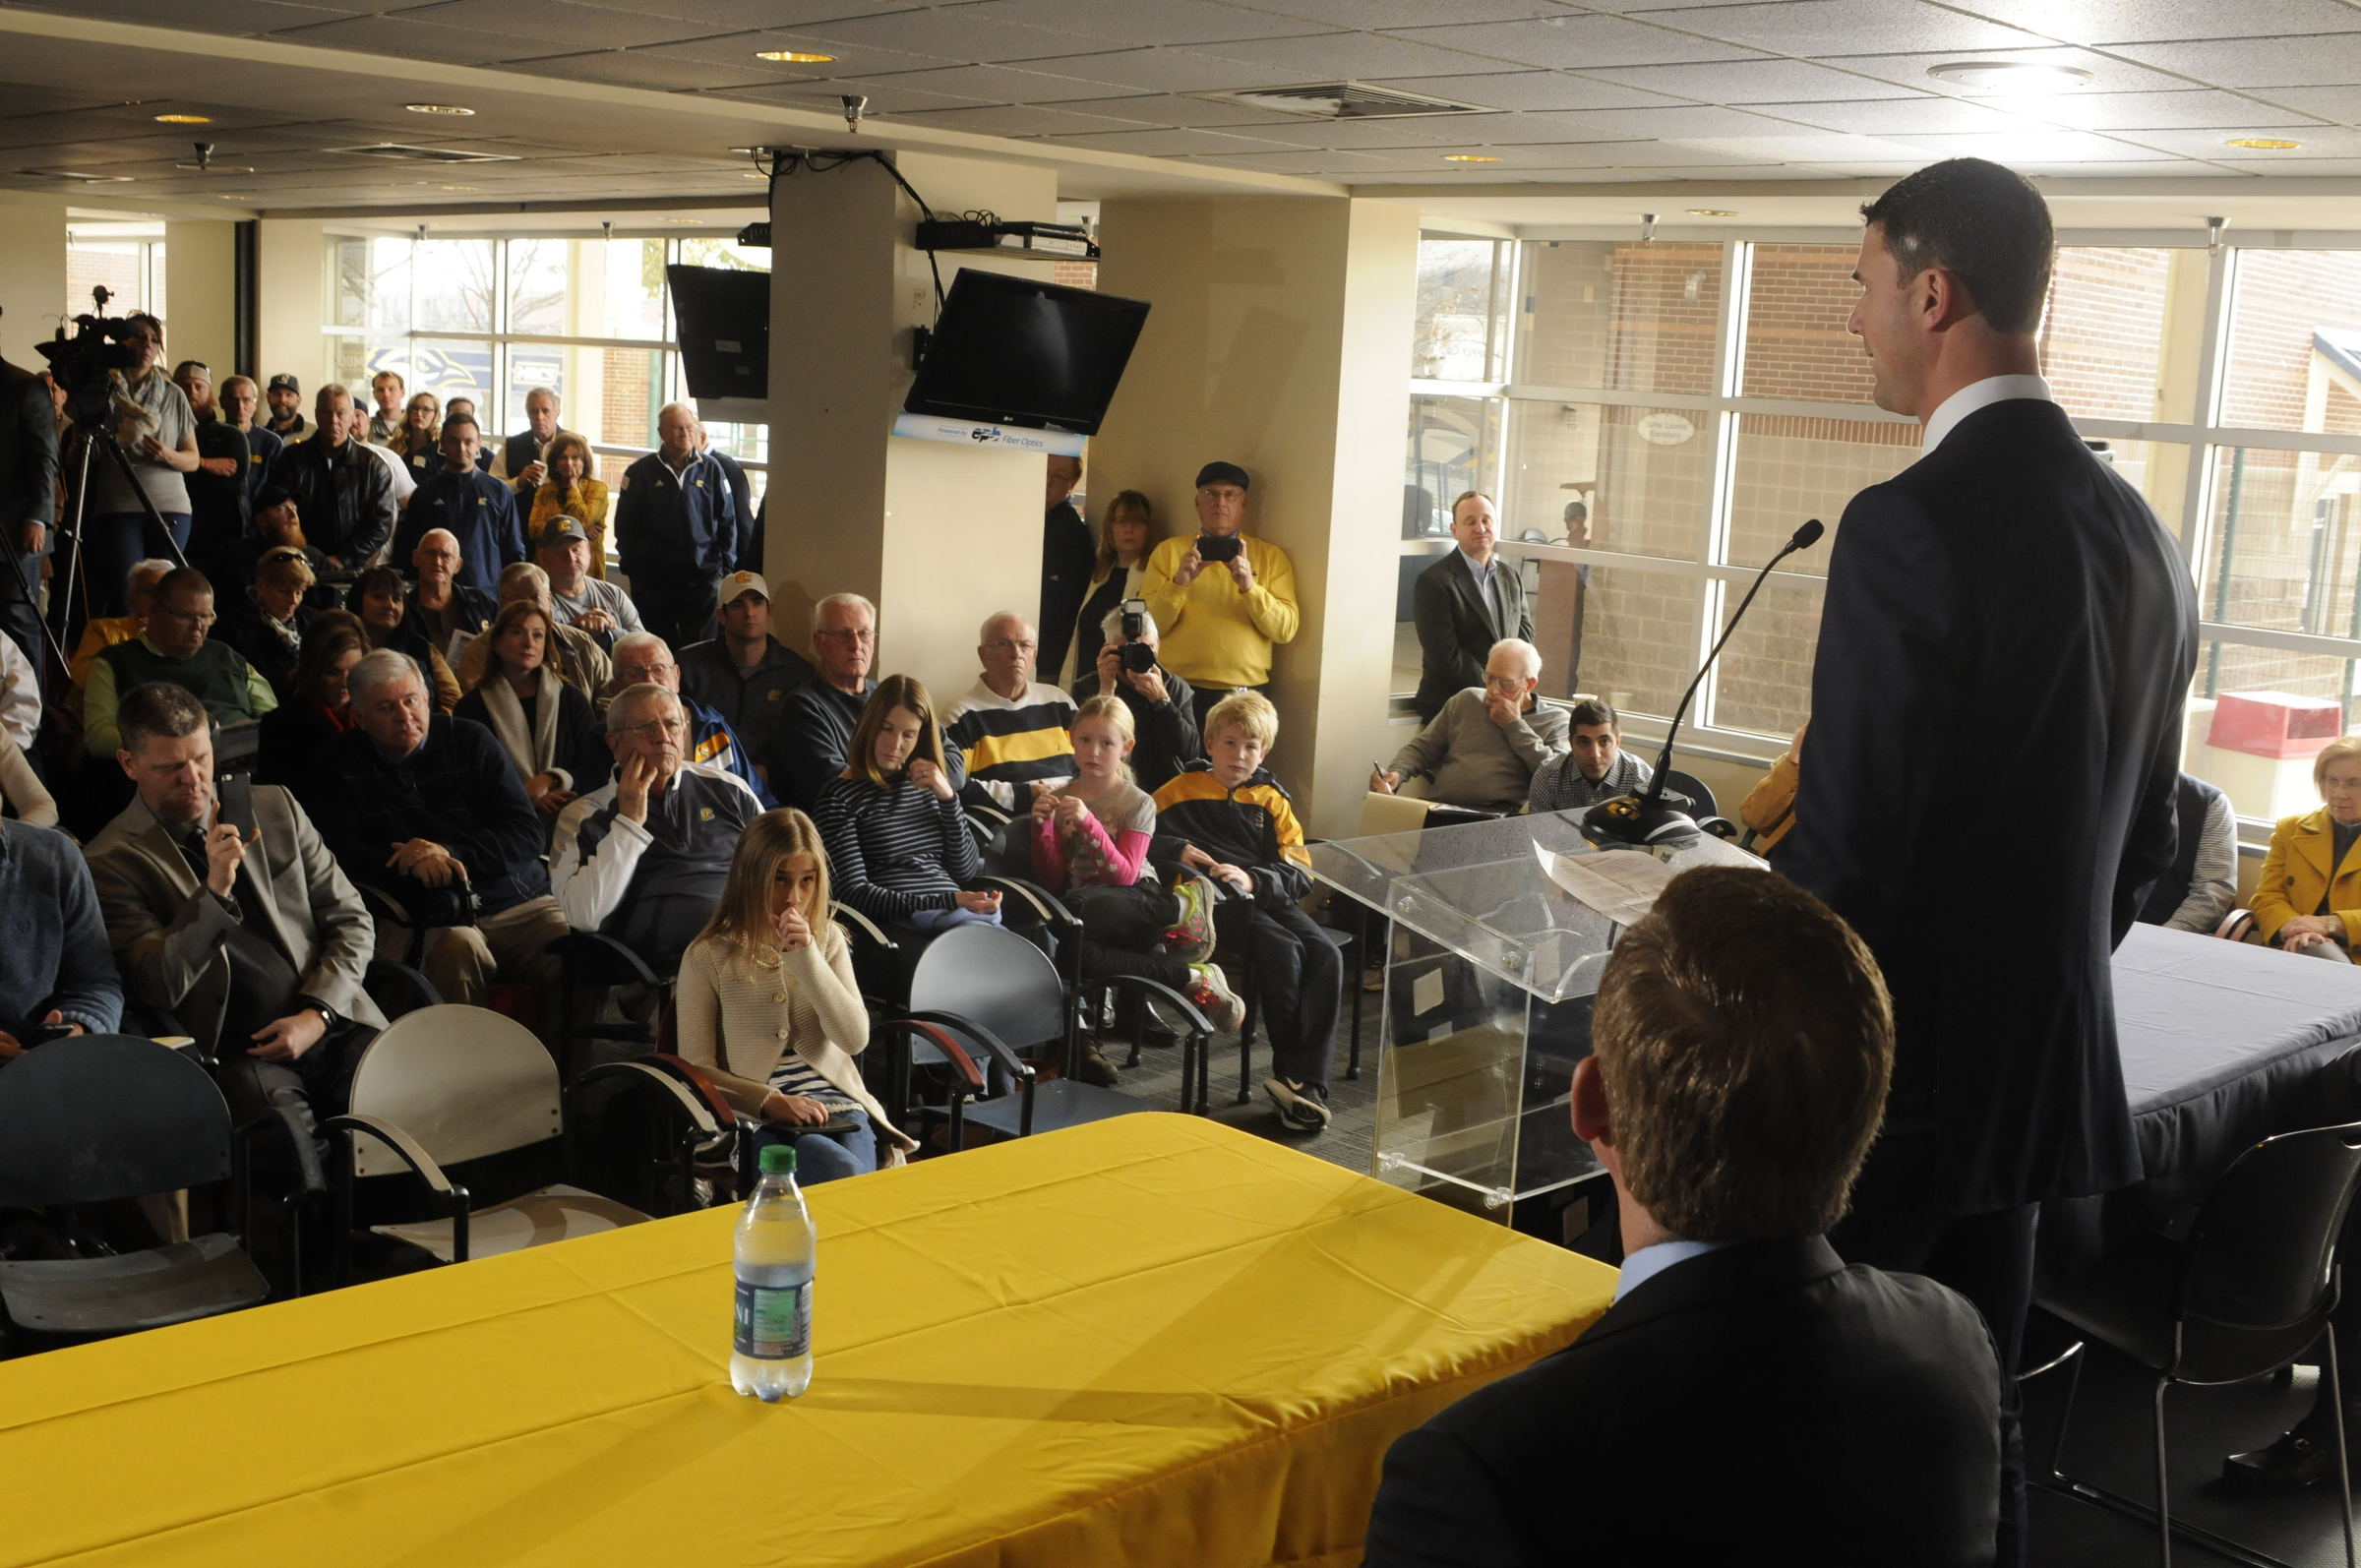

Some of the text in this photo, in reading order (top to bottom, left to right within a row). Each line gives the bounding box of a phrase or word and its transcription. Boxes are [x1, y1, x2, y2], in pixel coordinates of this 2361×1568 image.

[516, 365, 556, 382] MOCS
[1646, 420, 1687, 431] Suite Levels
[938, 427, 959, 436] Powered
[971, 426, 1001, 443] epb
[1001, 436, 1020, 445] Fiber
[1020, 437, 1044, 448] Optics
[1650, 429, 1681, 439] Elevators
